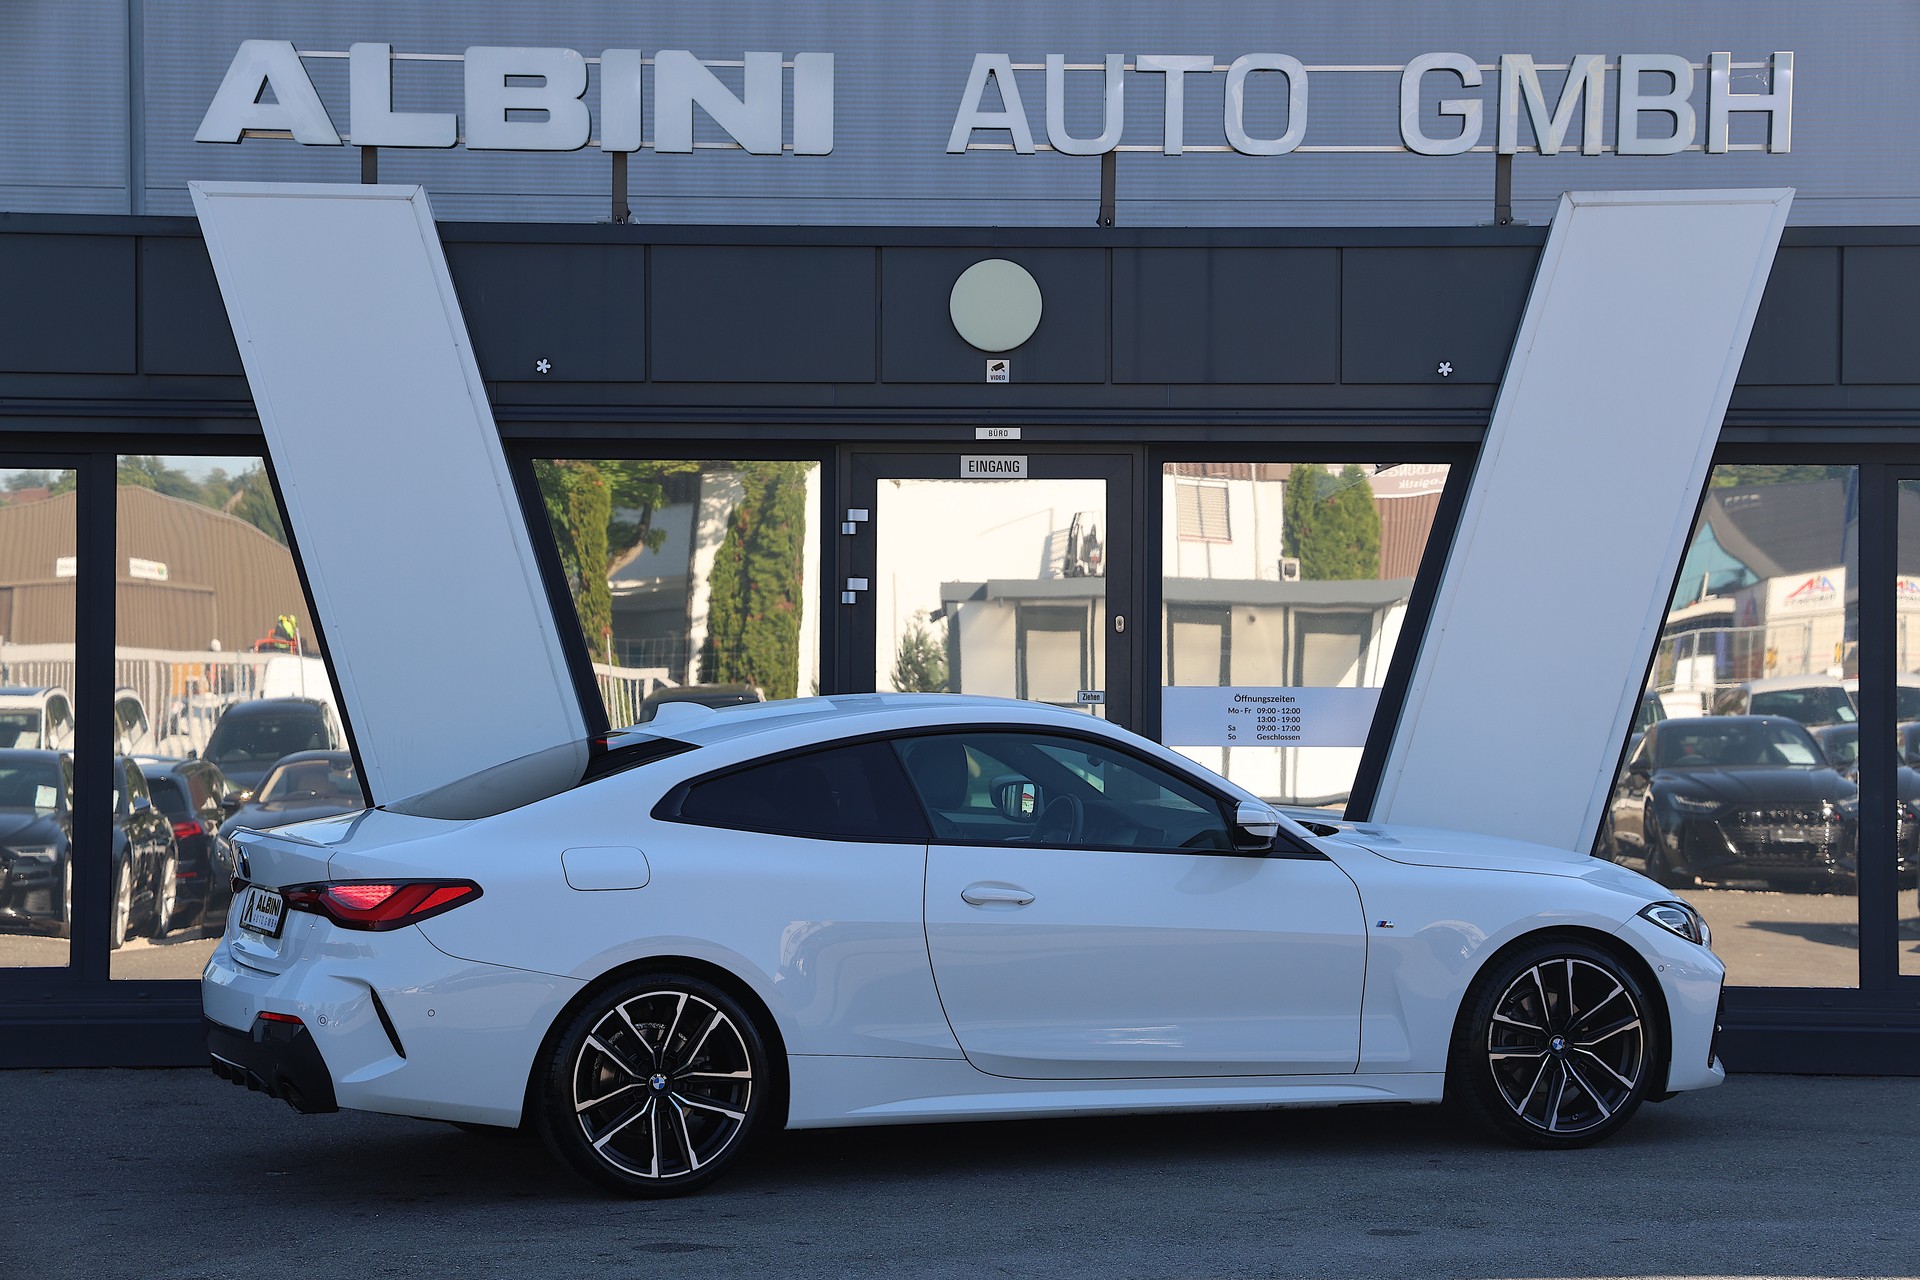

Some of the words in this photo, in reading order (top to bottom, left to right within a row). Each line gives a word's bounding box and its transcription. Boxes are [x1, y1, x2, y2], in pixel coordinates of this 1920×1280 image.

[193, 39, 835, 155] ALBINI
[946, 52, 1310, 157] AUTO
[1400, 51, 1795, 157] GMBH
[988, 429, 1009, 437] BÜRO
[968, 460, 1020, 473] EINGANG
[1082, 693, 1100, 701] Ziehen
[1234, 693, 1296, 704] Öffnungszeiten
[256, 894, 282, 917] ALBINI
